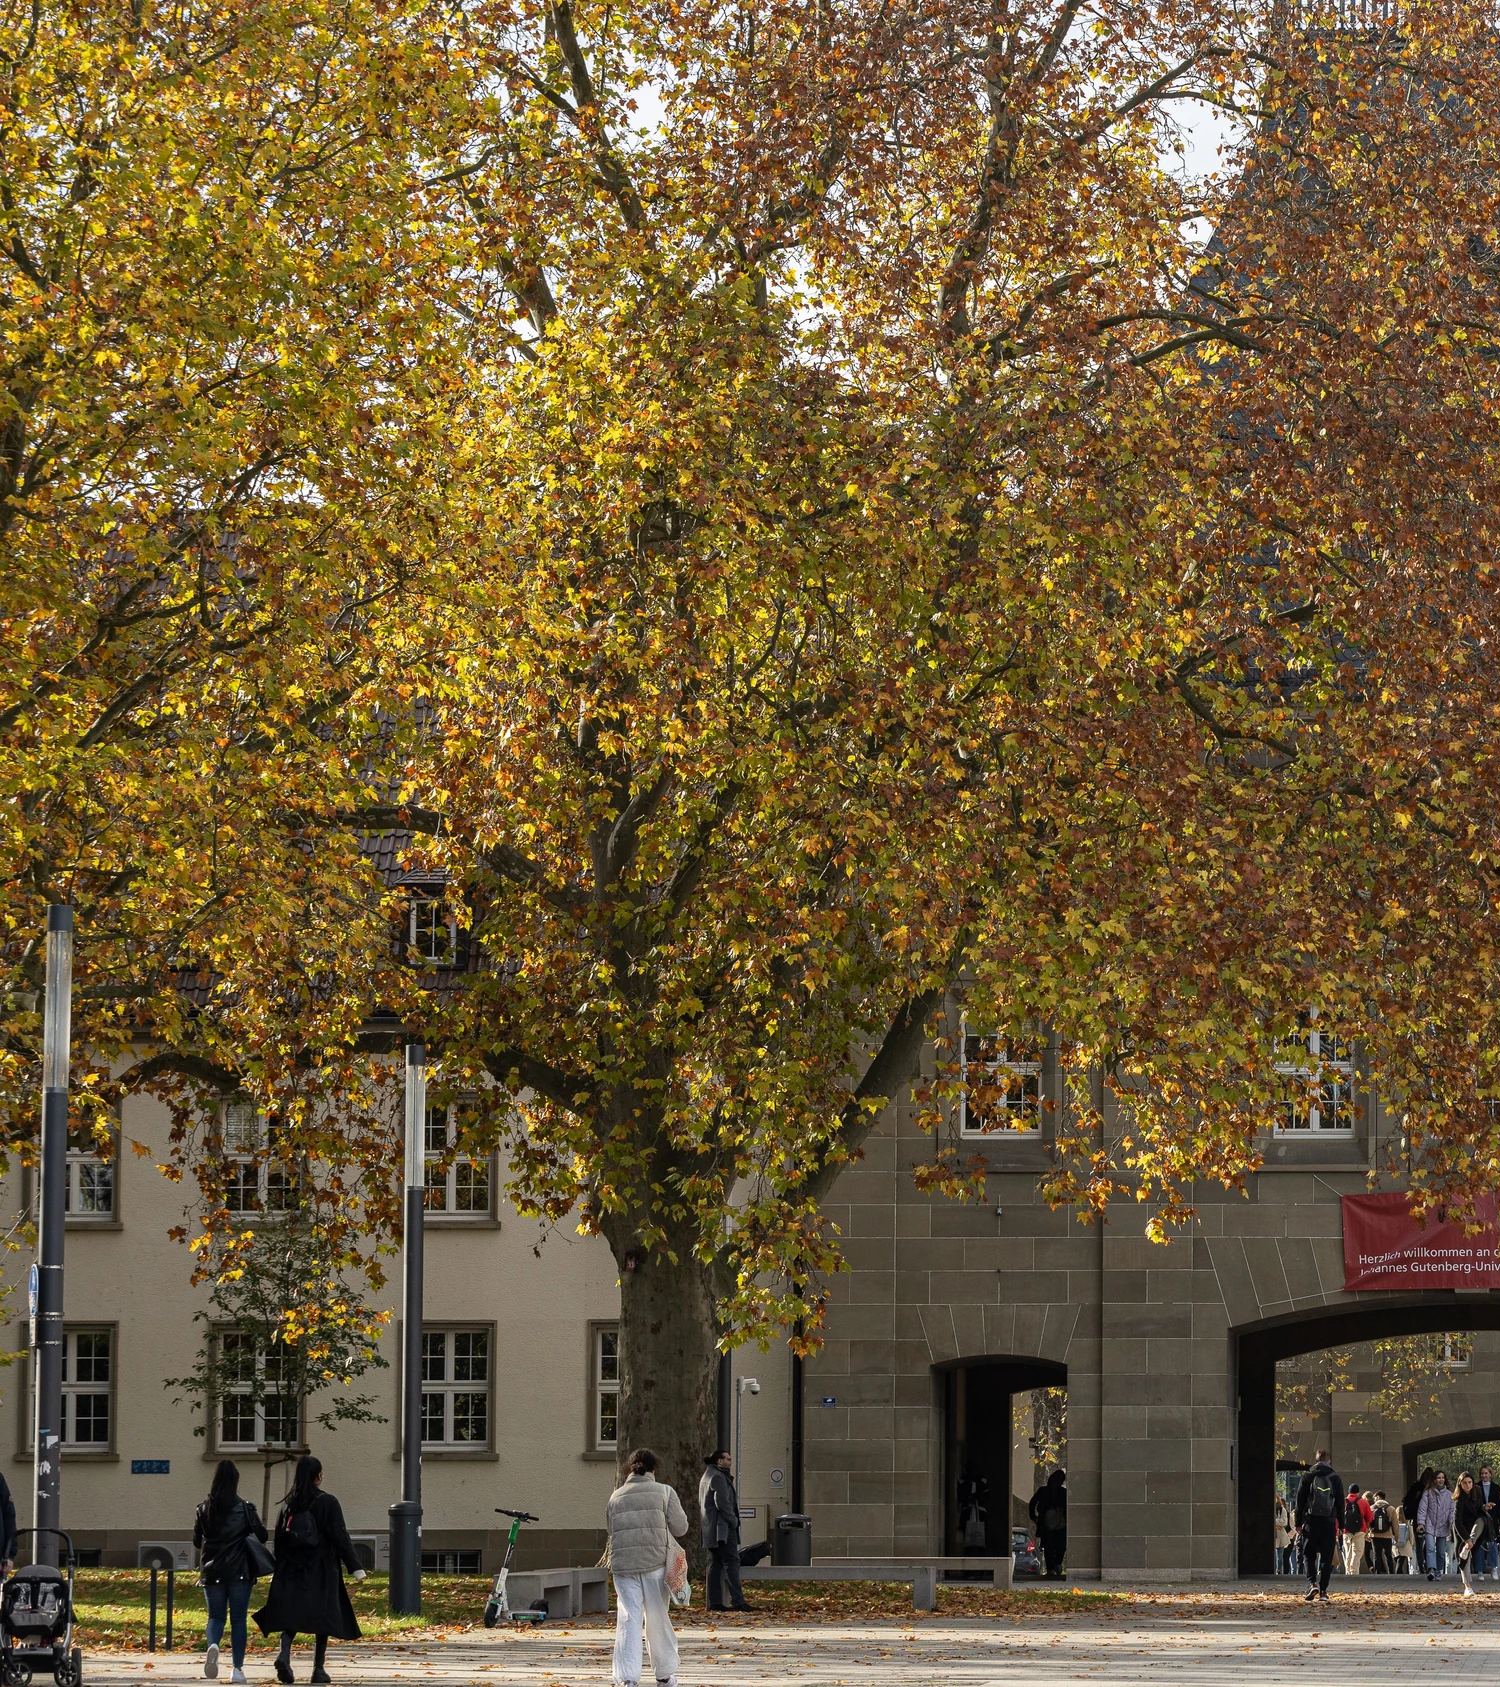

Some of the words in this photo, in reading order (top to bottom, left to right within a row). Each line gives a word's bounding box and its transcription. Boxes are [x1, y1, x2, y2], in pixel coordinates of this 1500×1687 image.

[1359, 1251, 1401, 1265] Herzlich
[1403, 1247, 1473, 1258] willkommen
[1476, 1248, 1490, 1257] an
